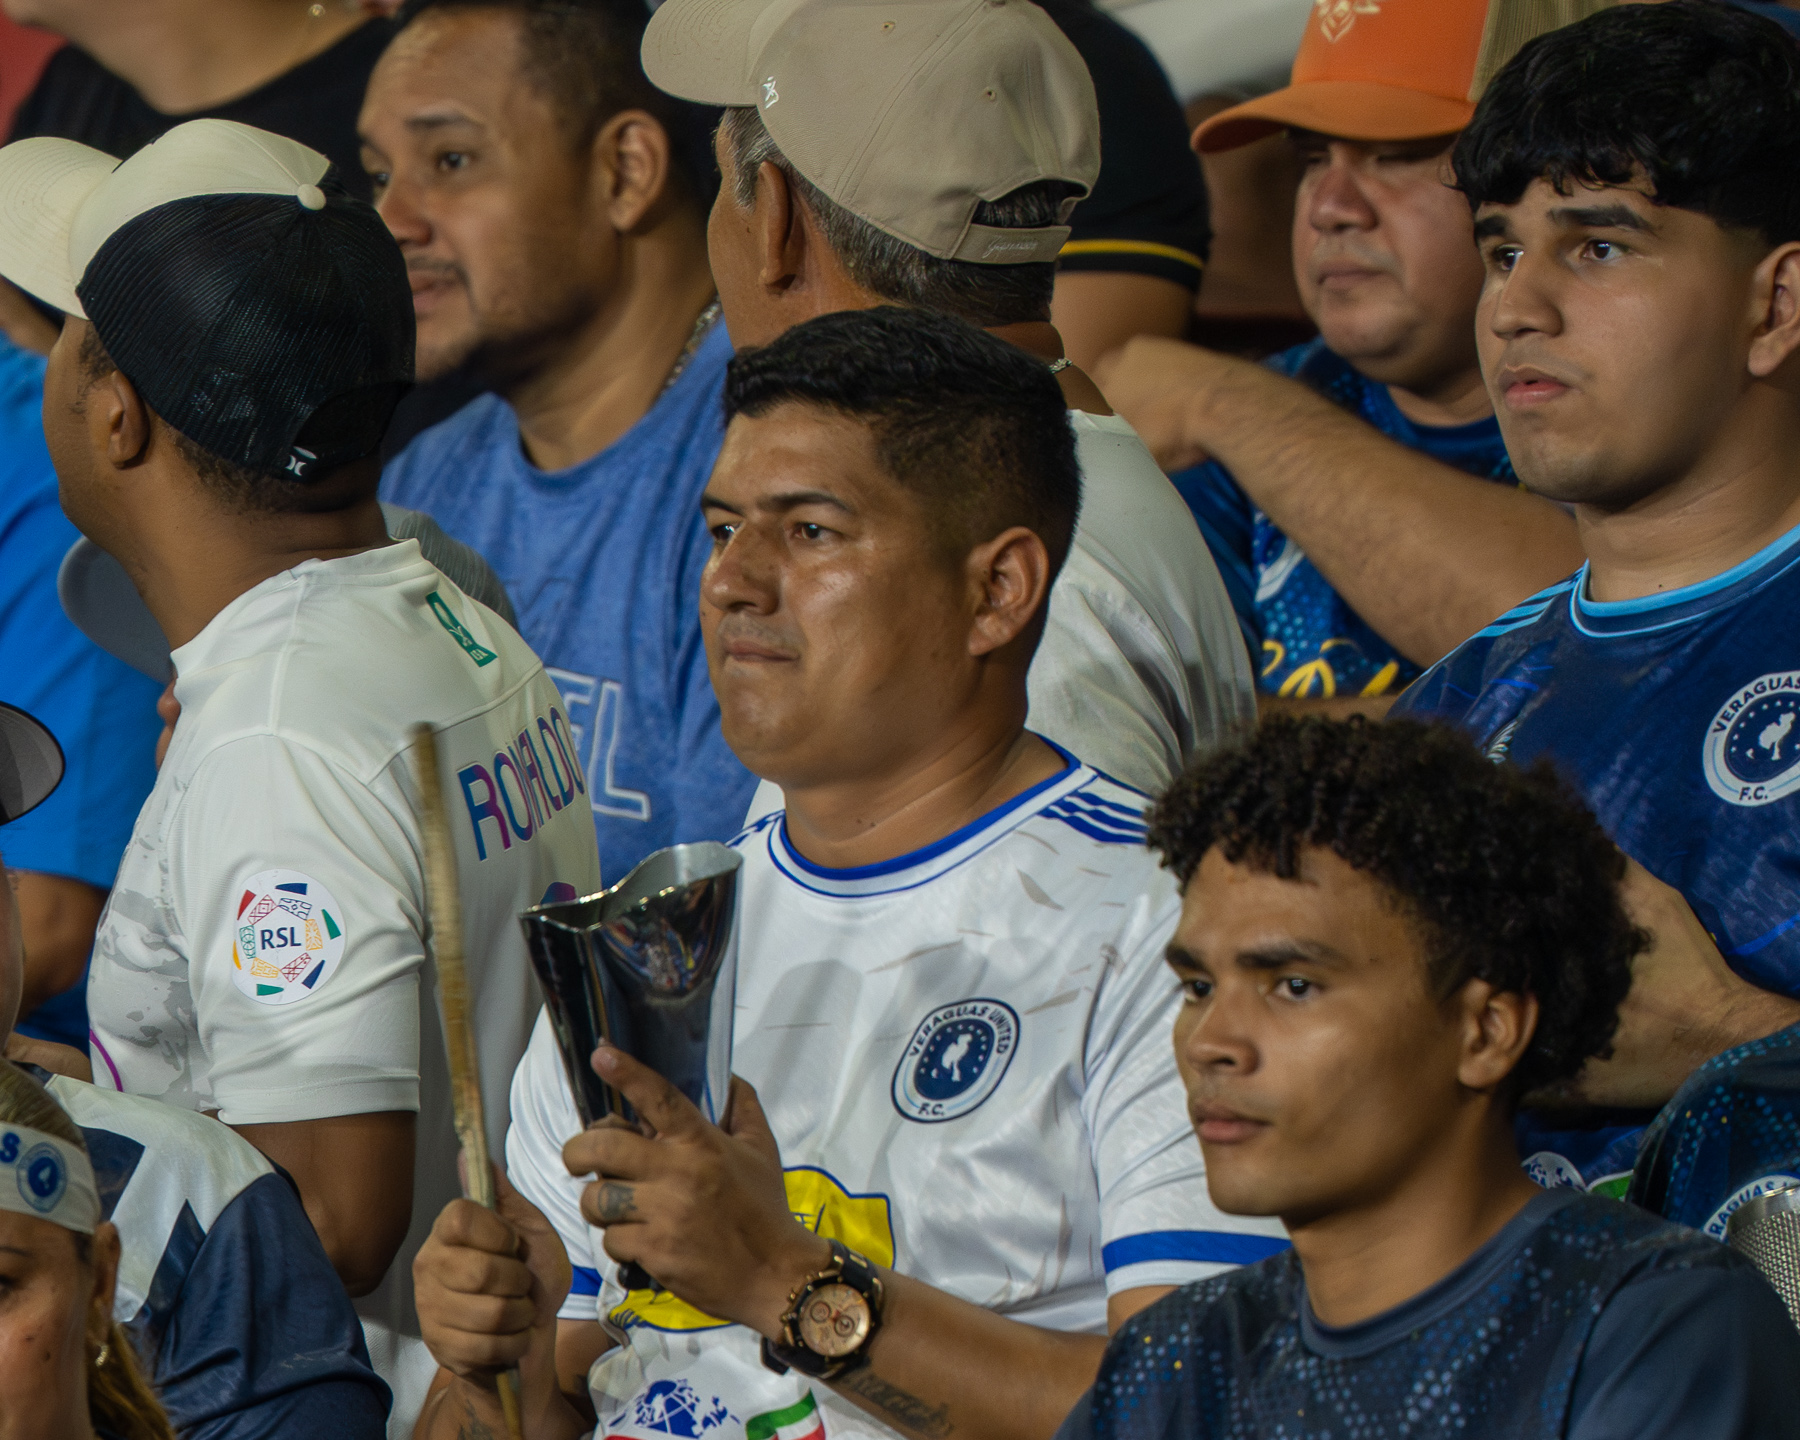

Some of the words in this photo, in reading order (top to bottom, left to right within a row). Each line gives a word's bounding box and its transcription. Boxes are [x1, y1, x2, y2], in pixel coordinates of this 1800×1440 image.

[1739, 786, 1768, 801] F.C.
[260, 926, 301, 950] RSL
[909, 1005, 989, 1056] VERAGUAS
[1709, 1181, 1775, 1238] RAGUAS
